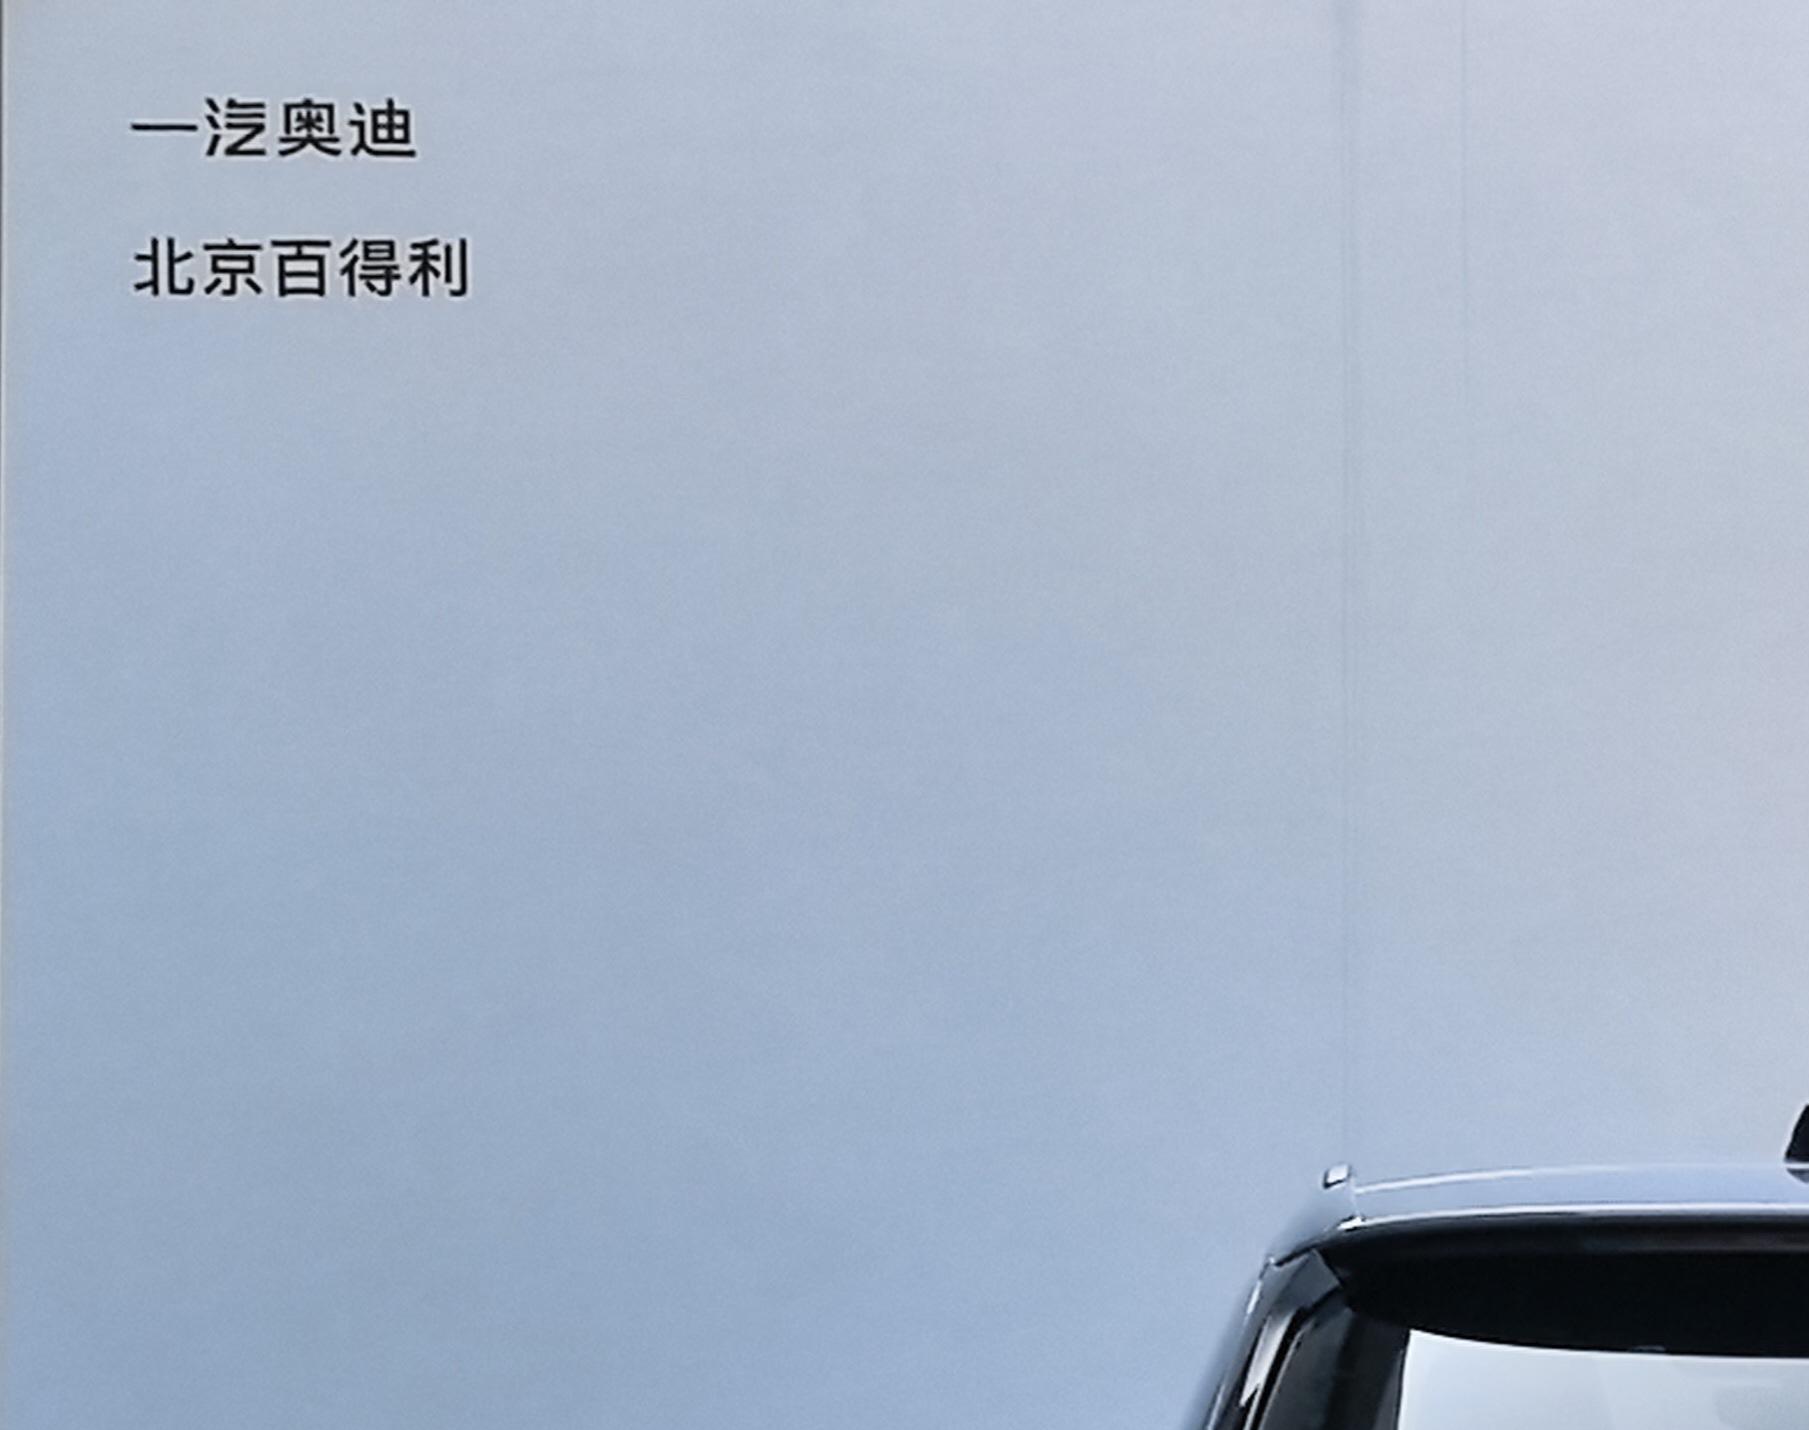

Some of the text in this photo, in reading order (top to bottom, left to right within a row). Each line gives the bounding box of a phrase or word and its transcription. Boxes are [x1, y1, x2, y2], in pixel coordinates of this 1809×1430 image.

[129, 96, 418, 159] 一汽奥迪
[132, 236, 469, 299] 北京百得利
